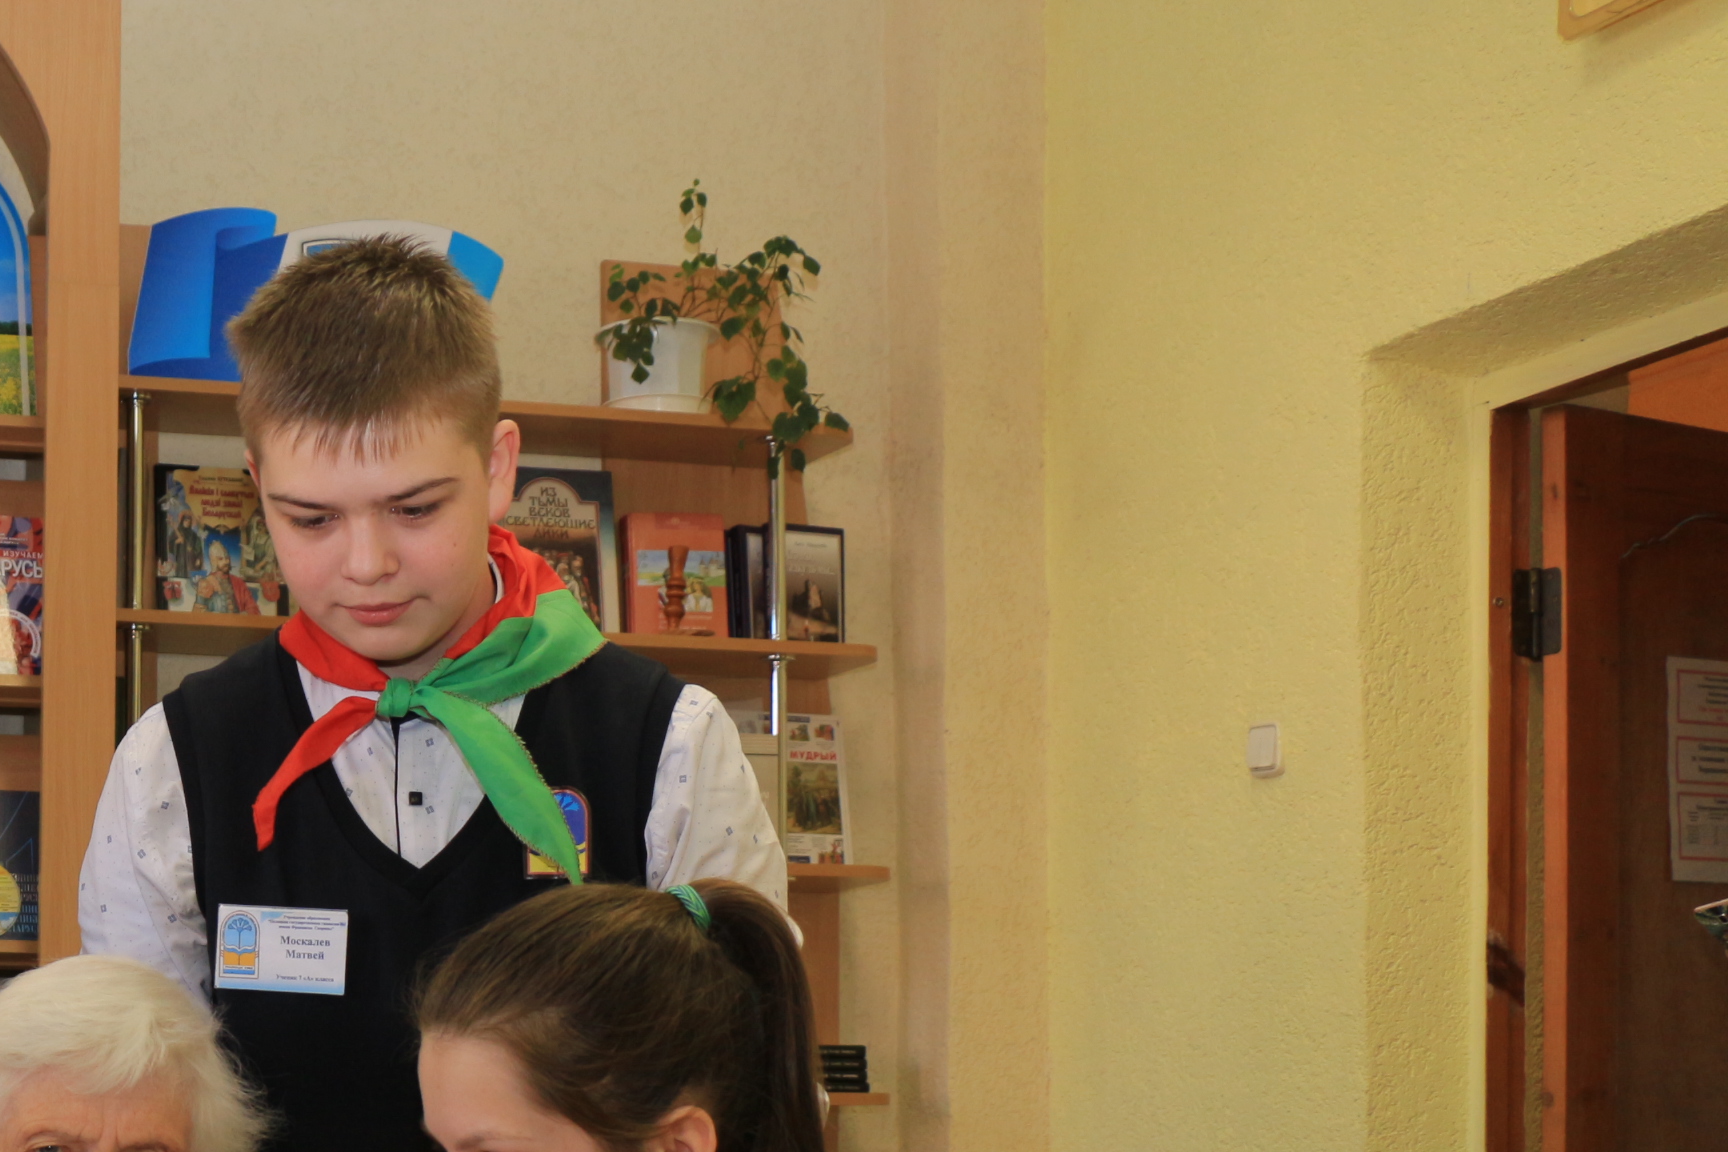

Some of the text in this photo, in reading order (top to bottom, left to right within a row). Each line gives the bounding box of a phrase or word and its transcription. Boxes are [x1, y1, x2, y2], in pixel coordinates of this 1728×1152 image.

[540, 487, 557, 497] ИЗ
[529, 496, 568, 507] ТЬМЫ
[529, 507, 571, 518] ВЕКОВ
[533, 529, 570, 540] ЛИКИ
[790, 750, 838, 761] МУДРЫЙ
[280, 935, 330, 947] Москалев
[285, 949, 325, 960] Матвей
